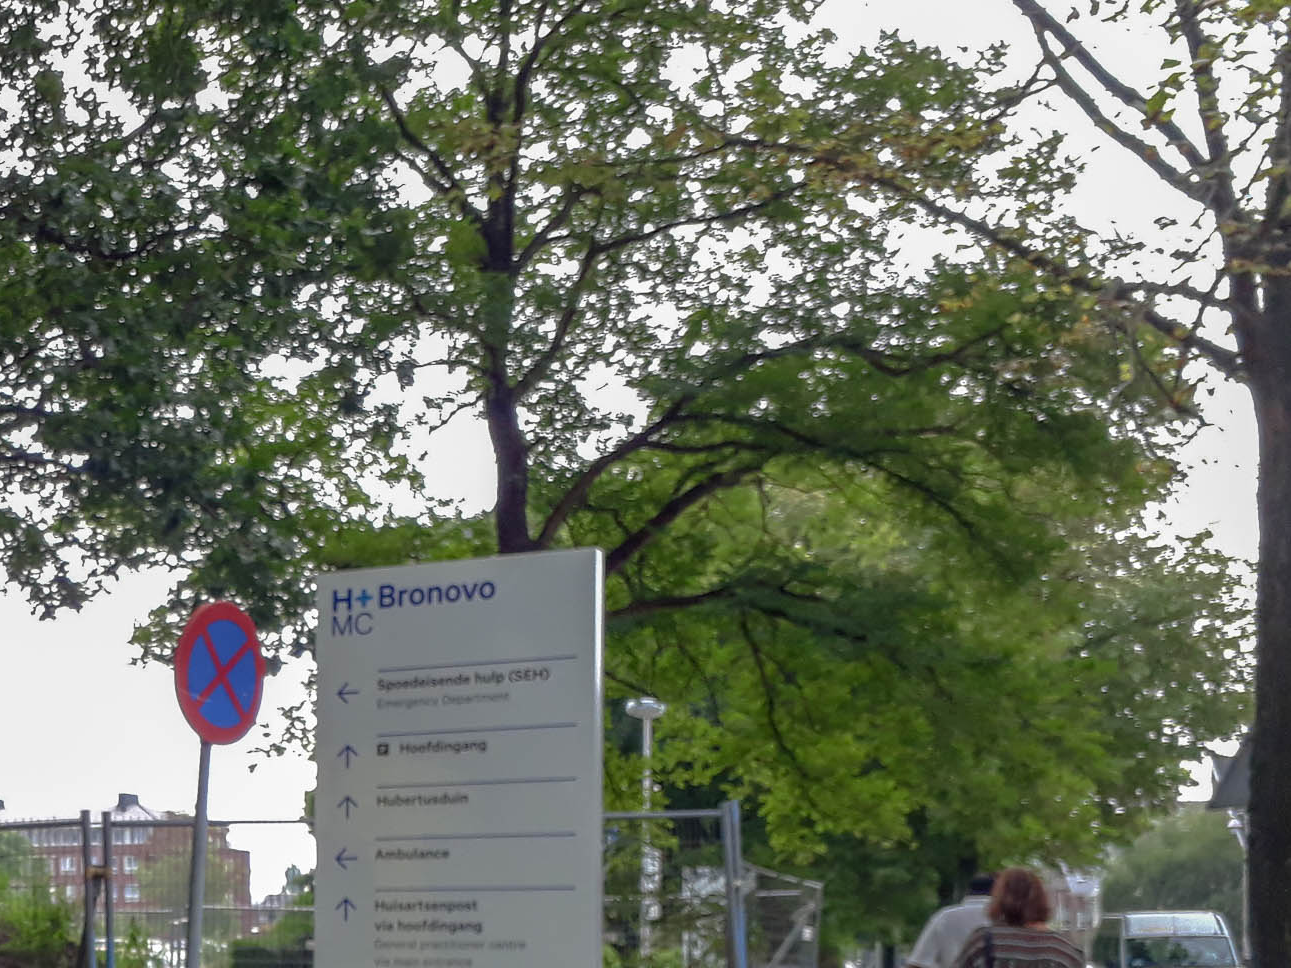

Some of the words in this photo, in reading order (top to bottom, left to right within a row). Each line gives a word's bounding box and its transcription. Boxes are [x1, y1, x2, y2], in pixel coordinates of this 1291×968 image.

[332, 612, 373, 636] MC
[377, 674, 470, 692] Spoedeisende
[474, 671, 505, 685] hulp
[508, 667, 550, 684] (SEH)
[399, 740, 487, 755] Hoofdingang
[374, 848, 450, 861] Ambulance
[374, 900, 478, 913] Huisartsenpost
[374, 921, 394, 932] via
[397, 919, 484, 934] hoofdingang
